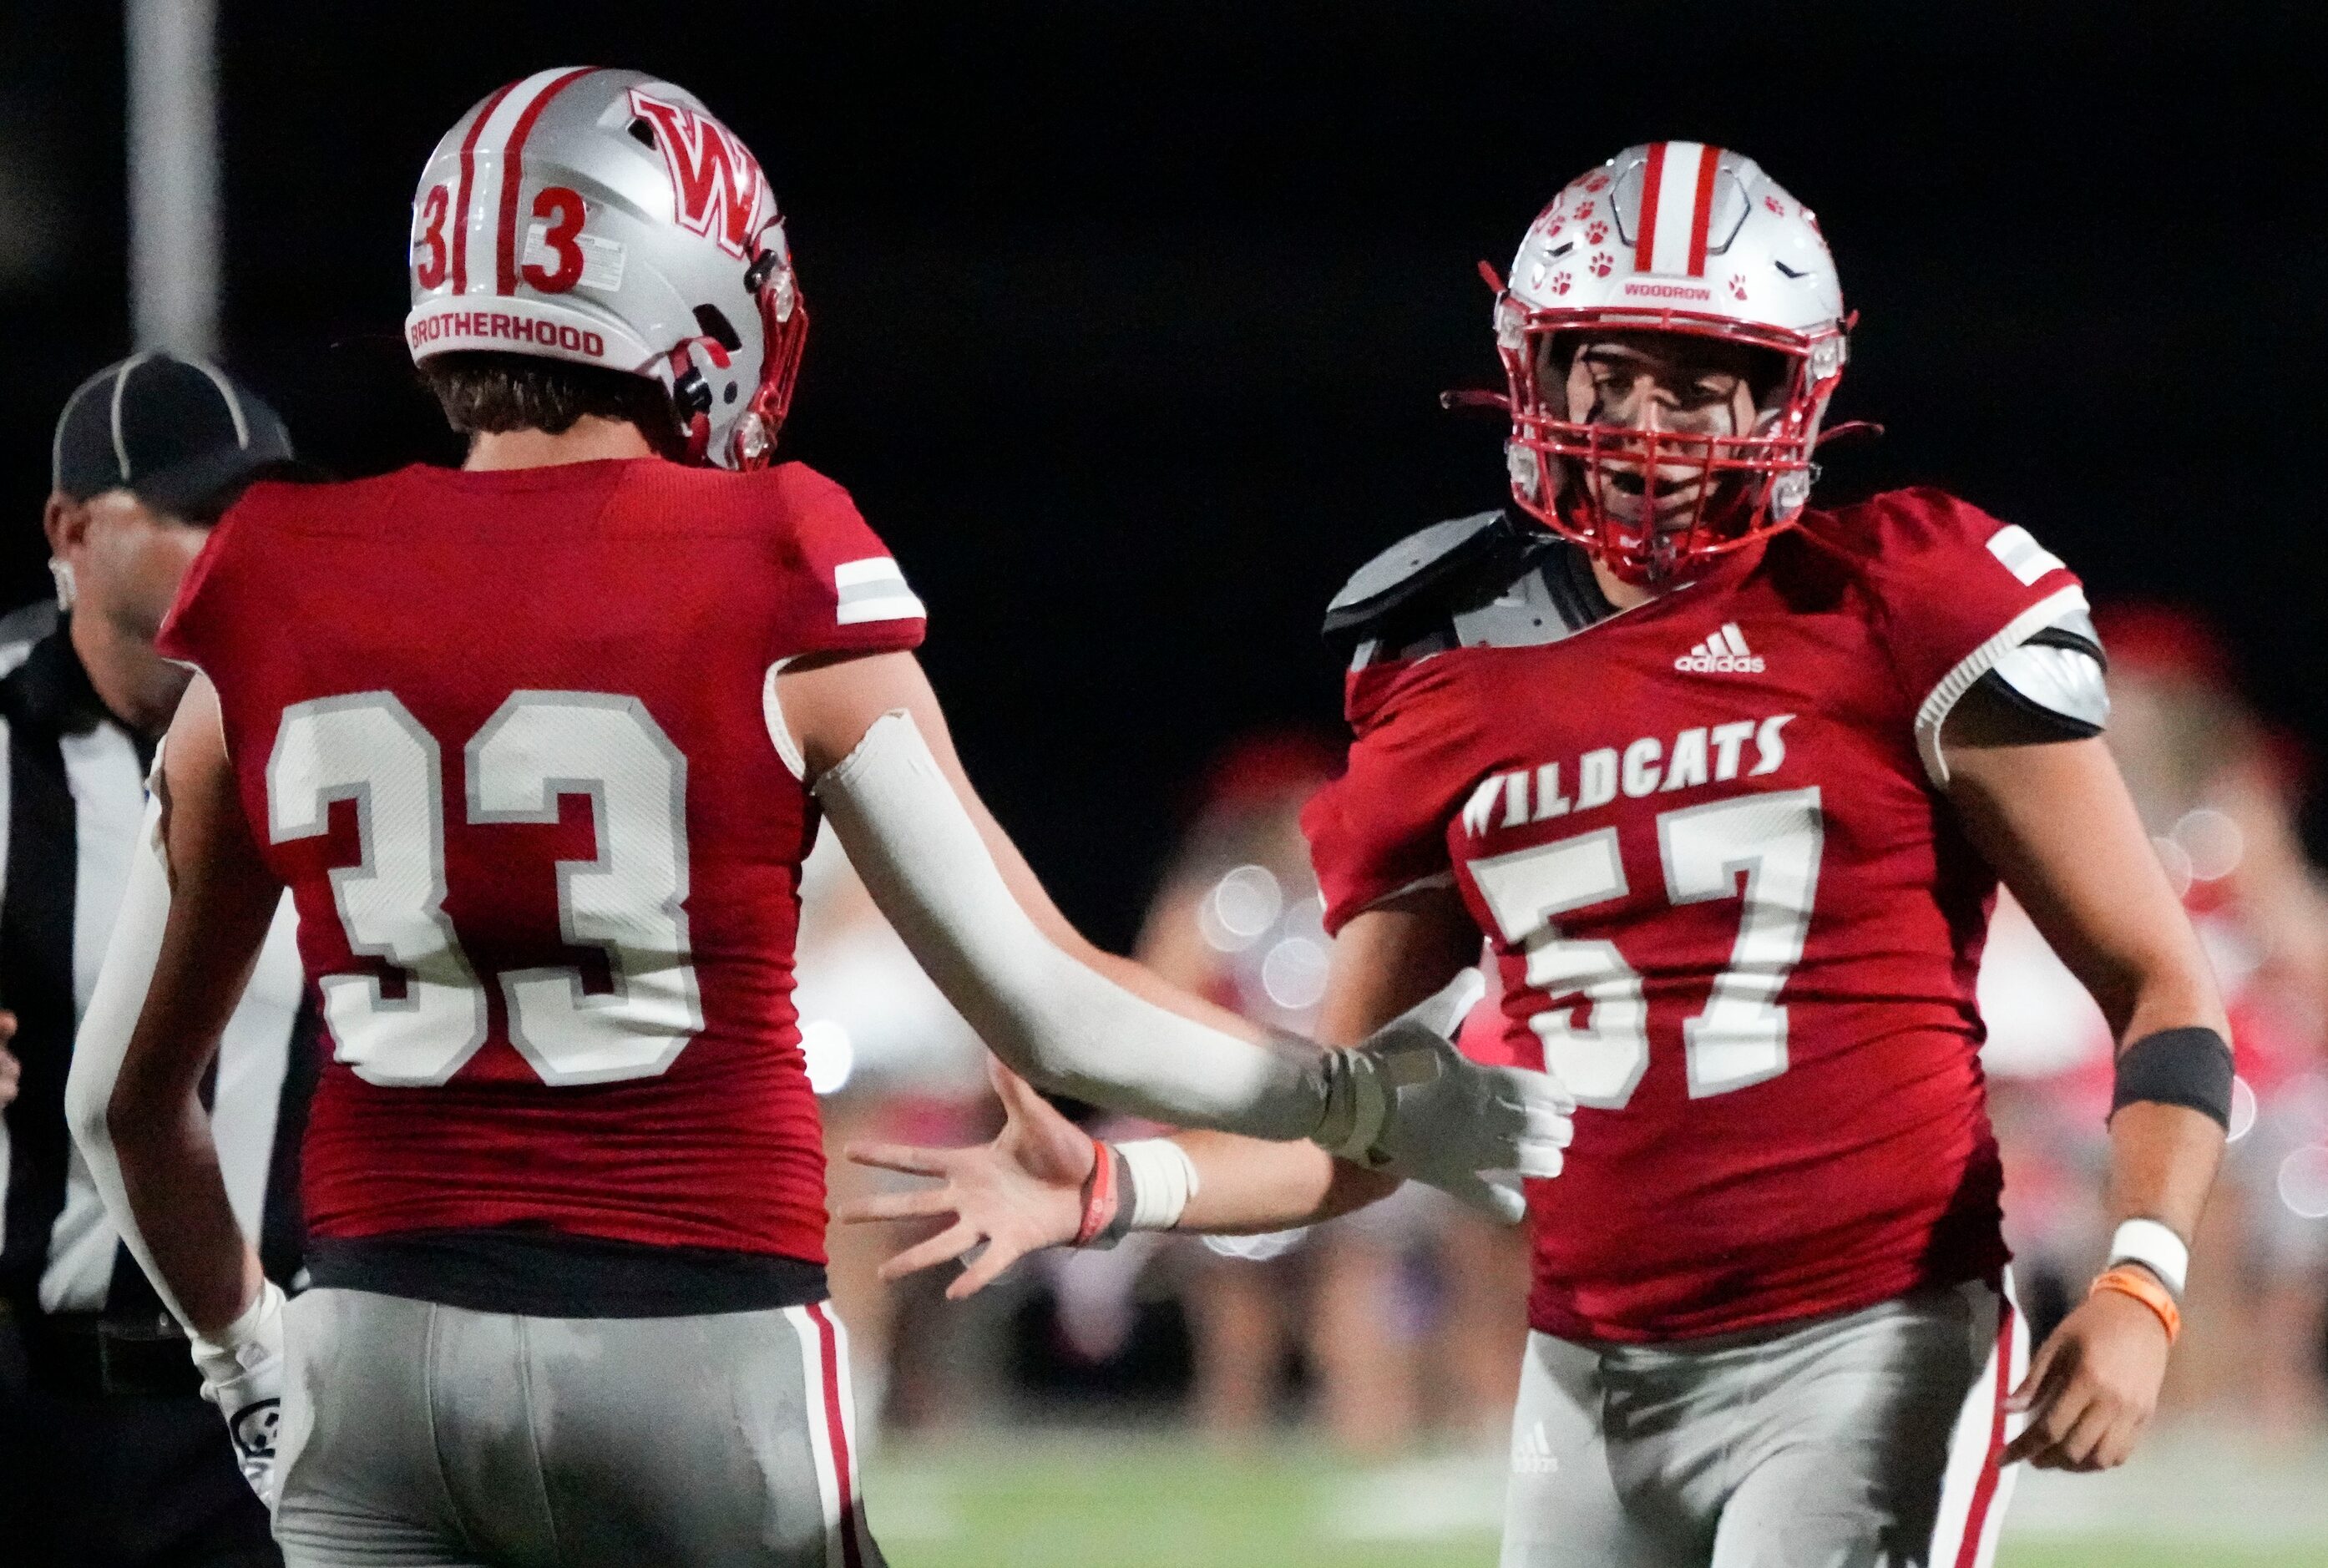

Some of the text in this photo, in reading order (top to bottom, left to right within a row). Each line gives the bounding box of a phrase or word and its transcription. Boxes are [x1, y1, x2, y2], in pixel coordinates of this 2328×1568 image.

[628, 89, 765, 260] W
[411, 312, 605, 357] BROTHERHOOD
[1625, 283, 1711, 301] WOODROW
[1674, 655, 1766, 673] adidas
[1463, 713, 1797, 838] WILDCATS
[266, 689, 705, 1086] 33
[1467, 786, 1824, 1110] 57
